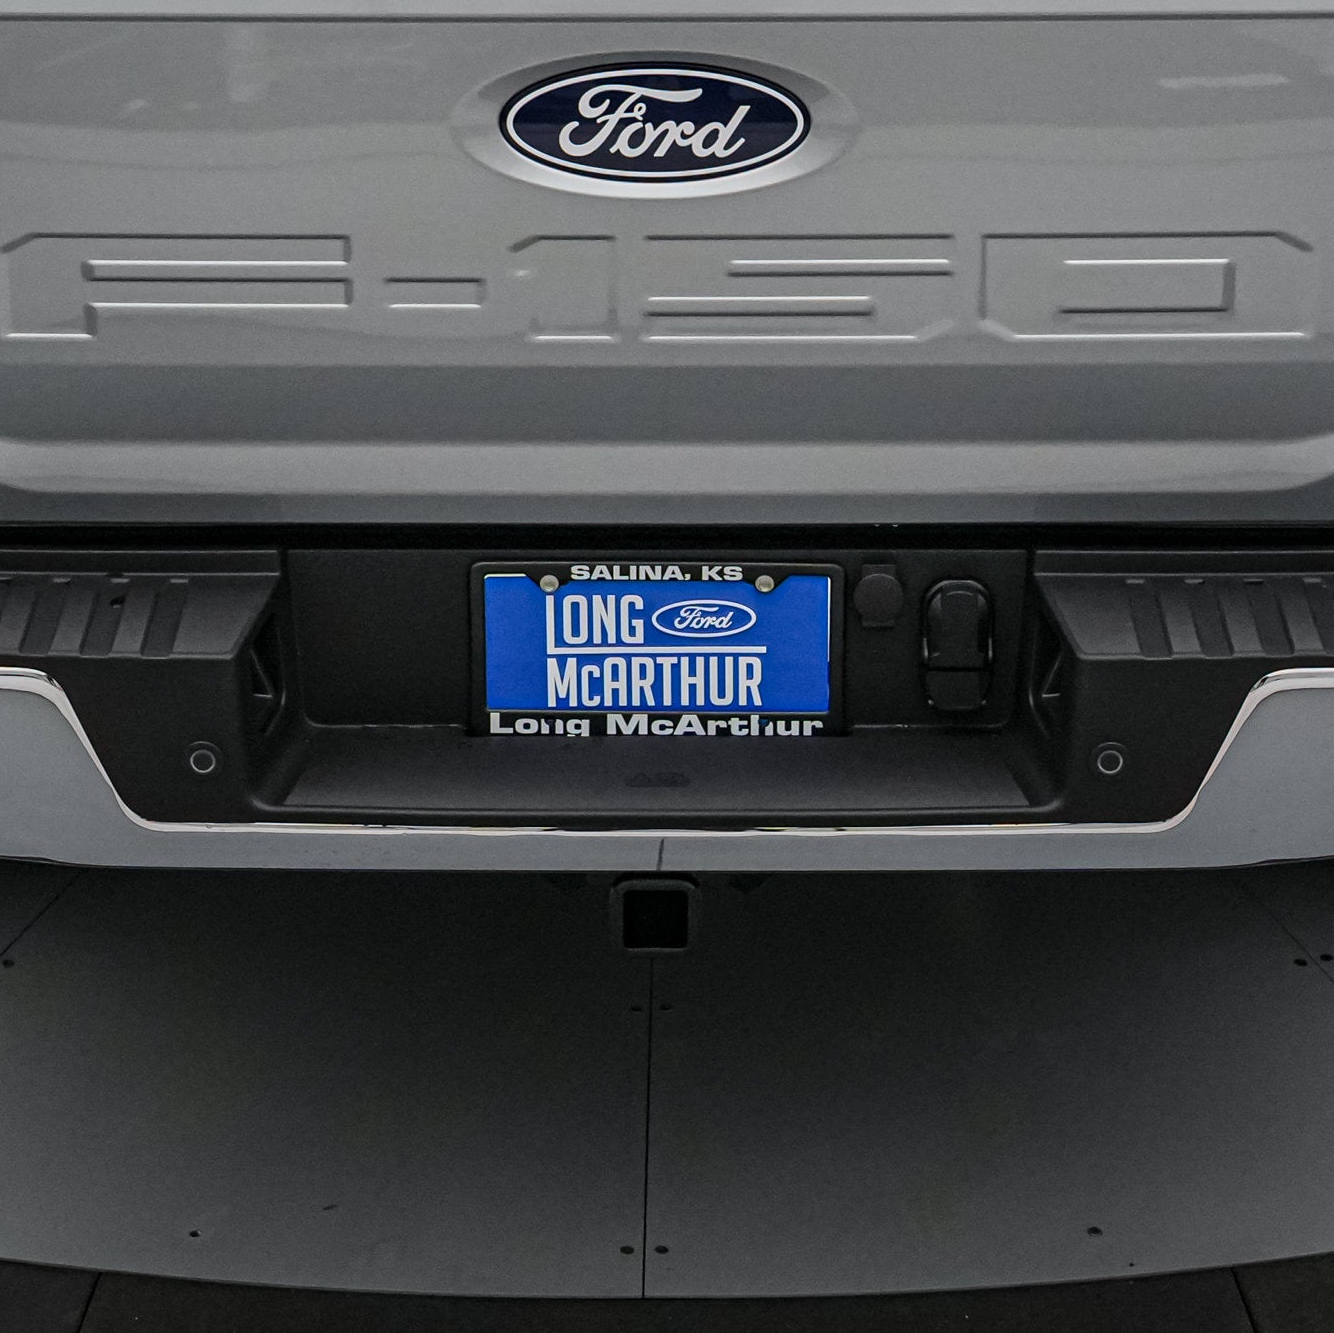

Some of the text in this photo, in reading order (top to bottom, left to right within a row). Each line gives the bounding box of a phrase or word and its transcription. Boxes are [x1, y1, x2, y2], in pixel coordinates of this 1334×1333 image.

[558, 83, 751, 158] Ford
[570, 564, 744, 582] SALINA, KS
[545, 594, 734, 652] LONG Ford
[546, 656, 763, 708] McARTHUR
[489, 712, 824, 737] Long McArthur
